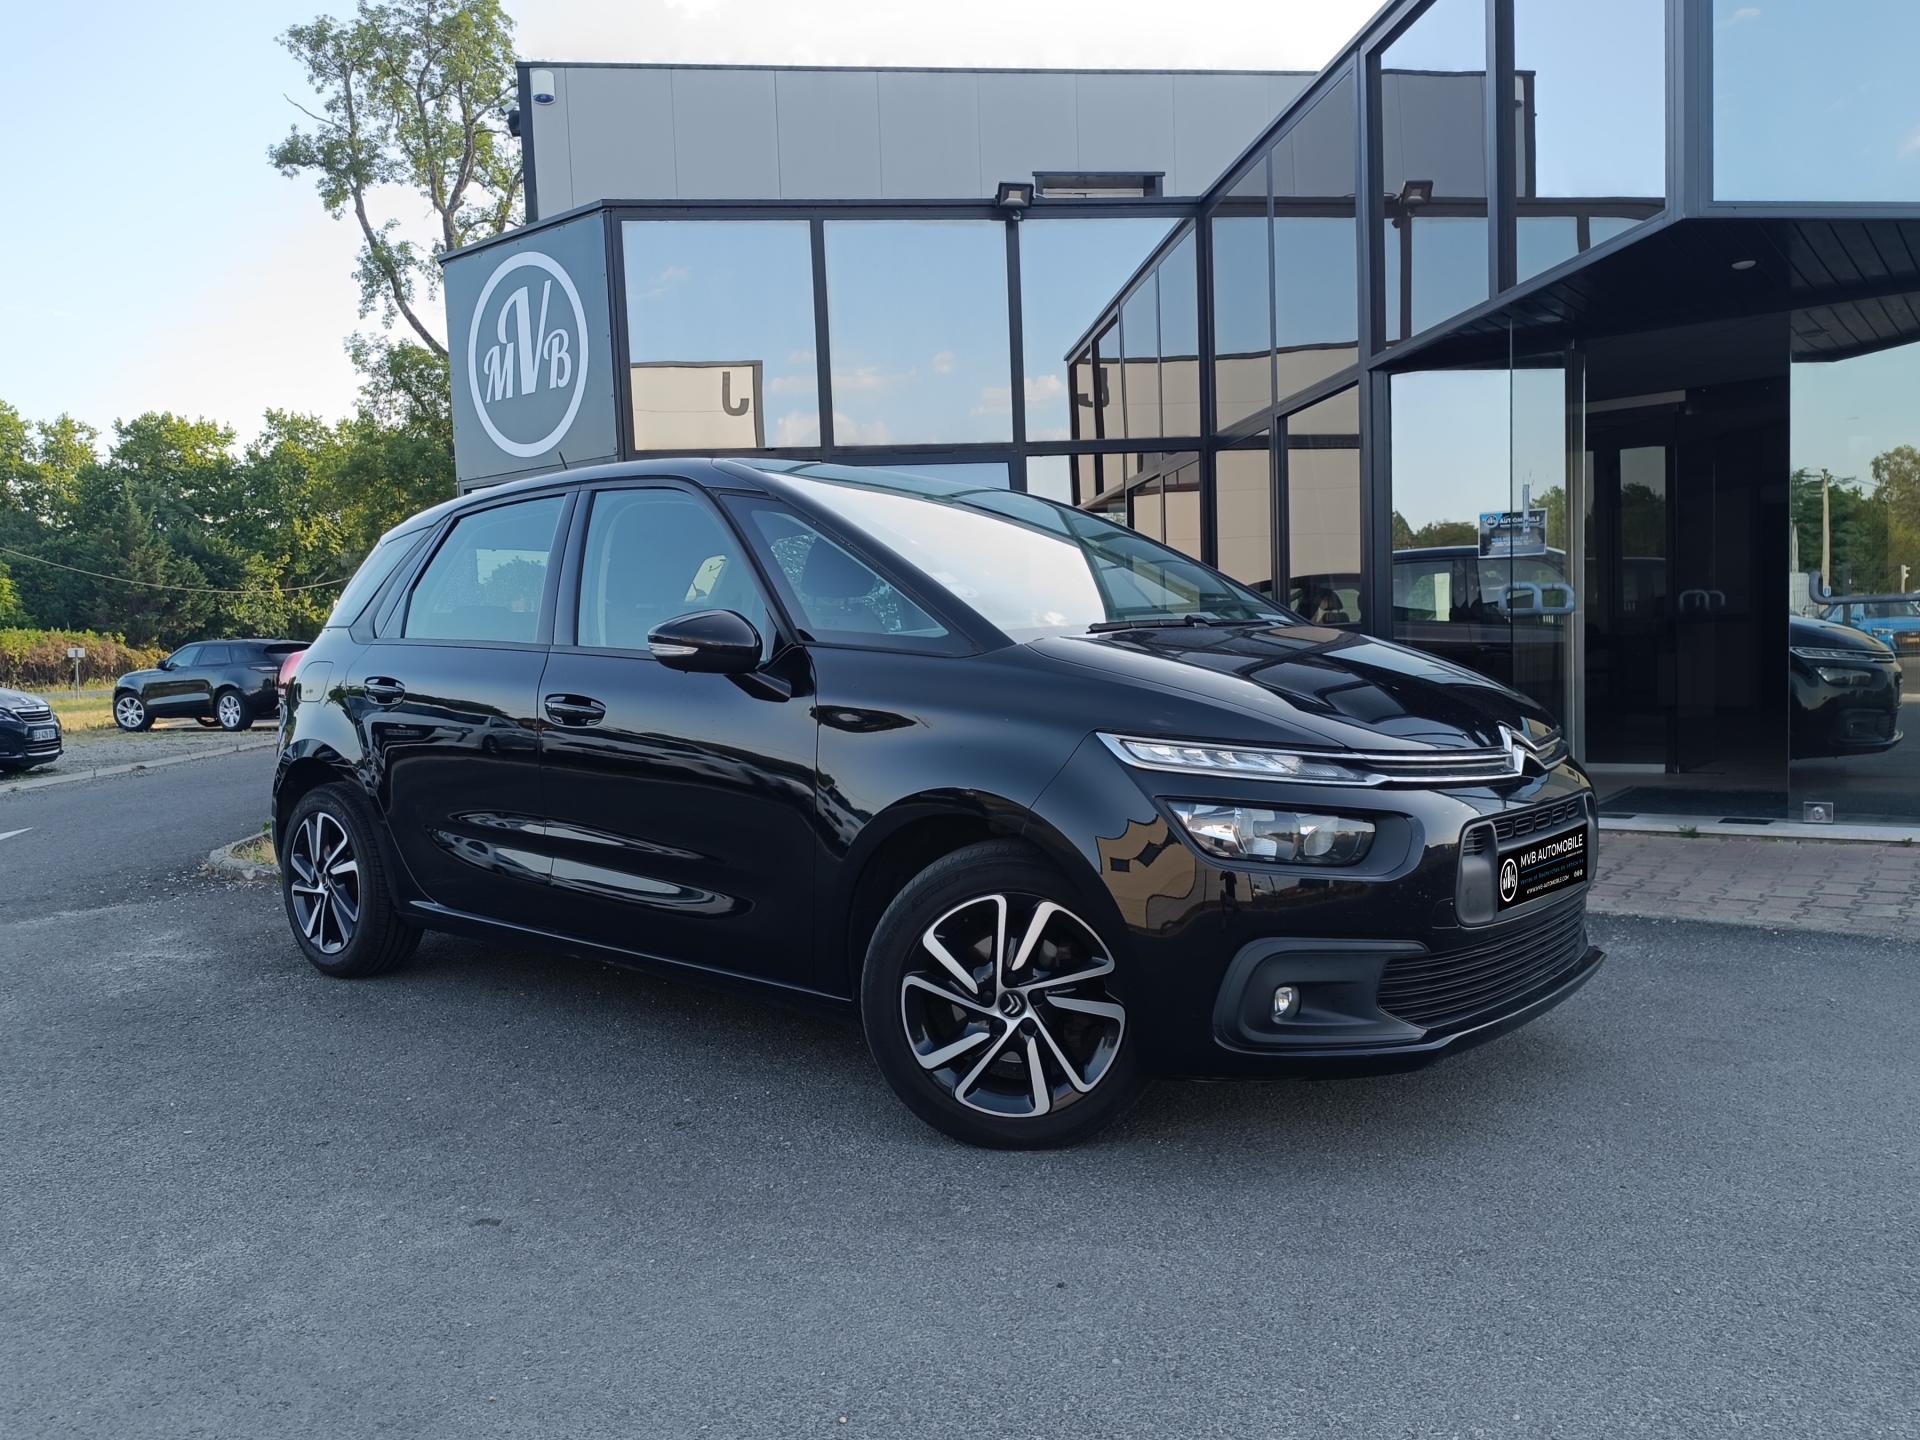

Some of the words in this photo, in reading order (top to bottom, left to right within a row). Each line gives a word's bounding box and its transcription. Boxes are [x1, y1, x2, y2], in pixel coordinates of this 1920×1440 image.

[483, 279, 572, 403] MVB
[1520, 851, 1537, 868] MVB
[1537, 833, 1583, 862] AUTOMOBILE
